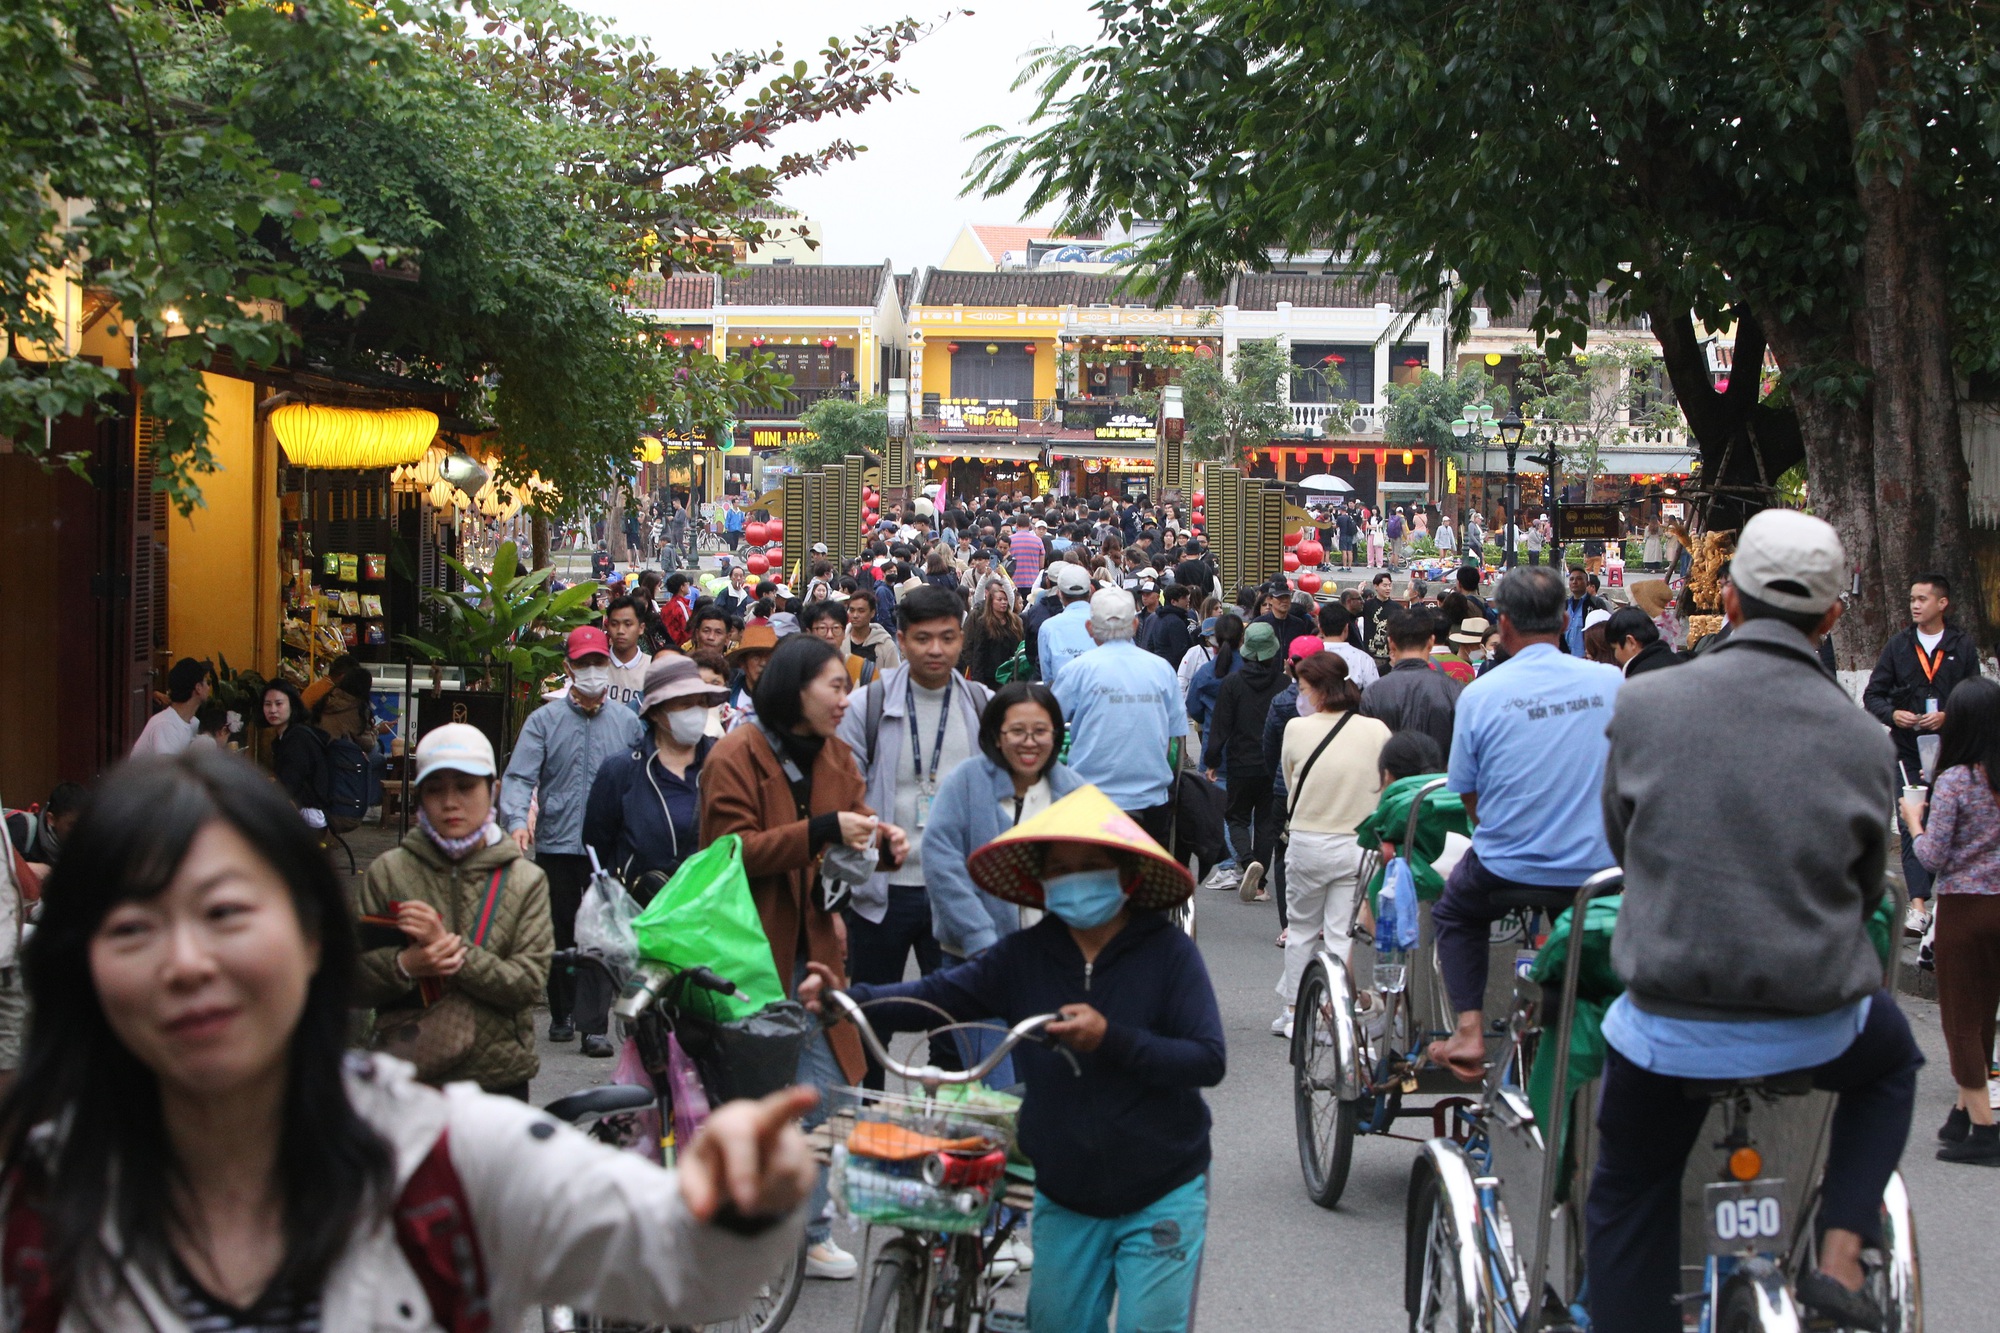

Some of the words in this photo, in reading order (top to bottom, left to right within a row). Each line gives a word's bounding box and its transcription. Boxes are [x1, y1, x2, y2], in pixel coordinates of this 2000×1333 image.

[939, 405, 962, 420] SPA
[754, 431, 781, 446] MINI
[1716, 1197, 1780, 1239] 050
